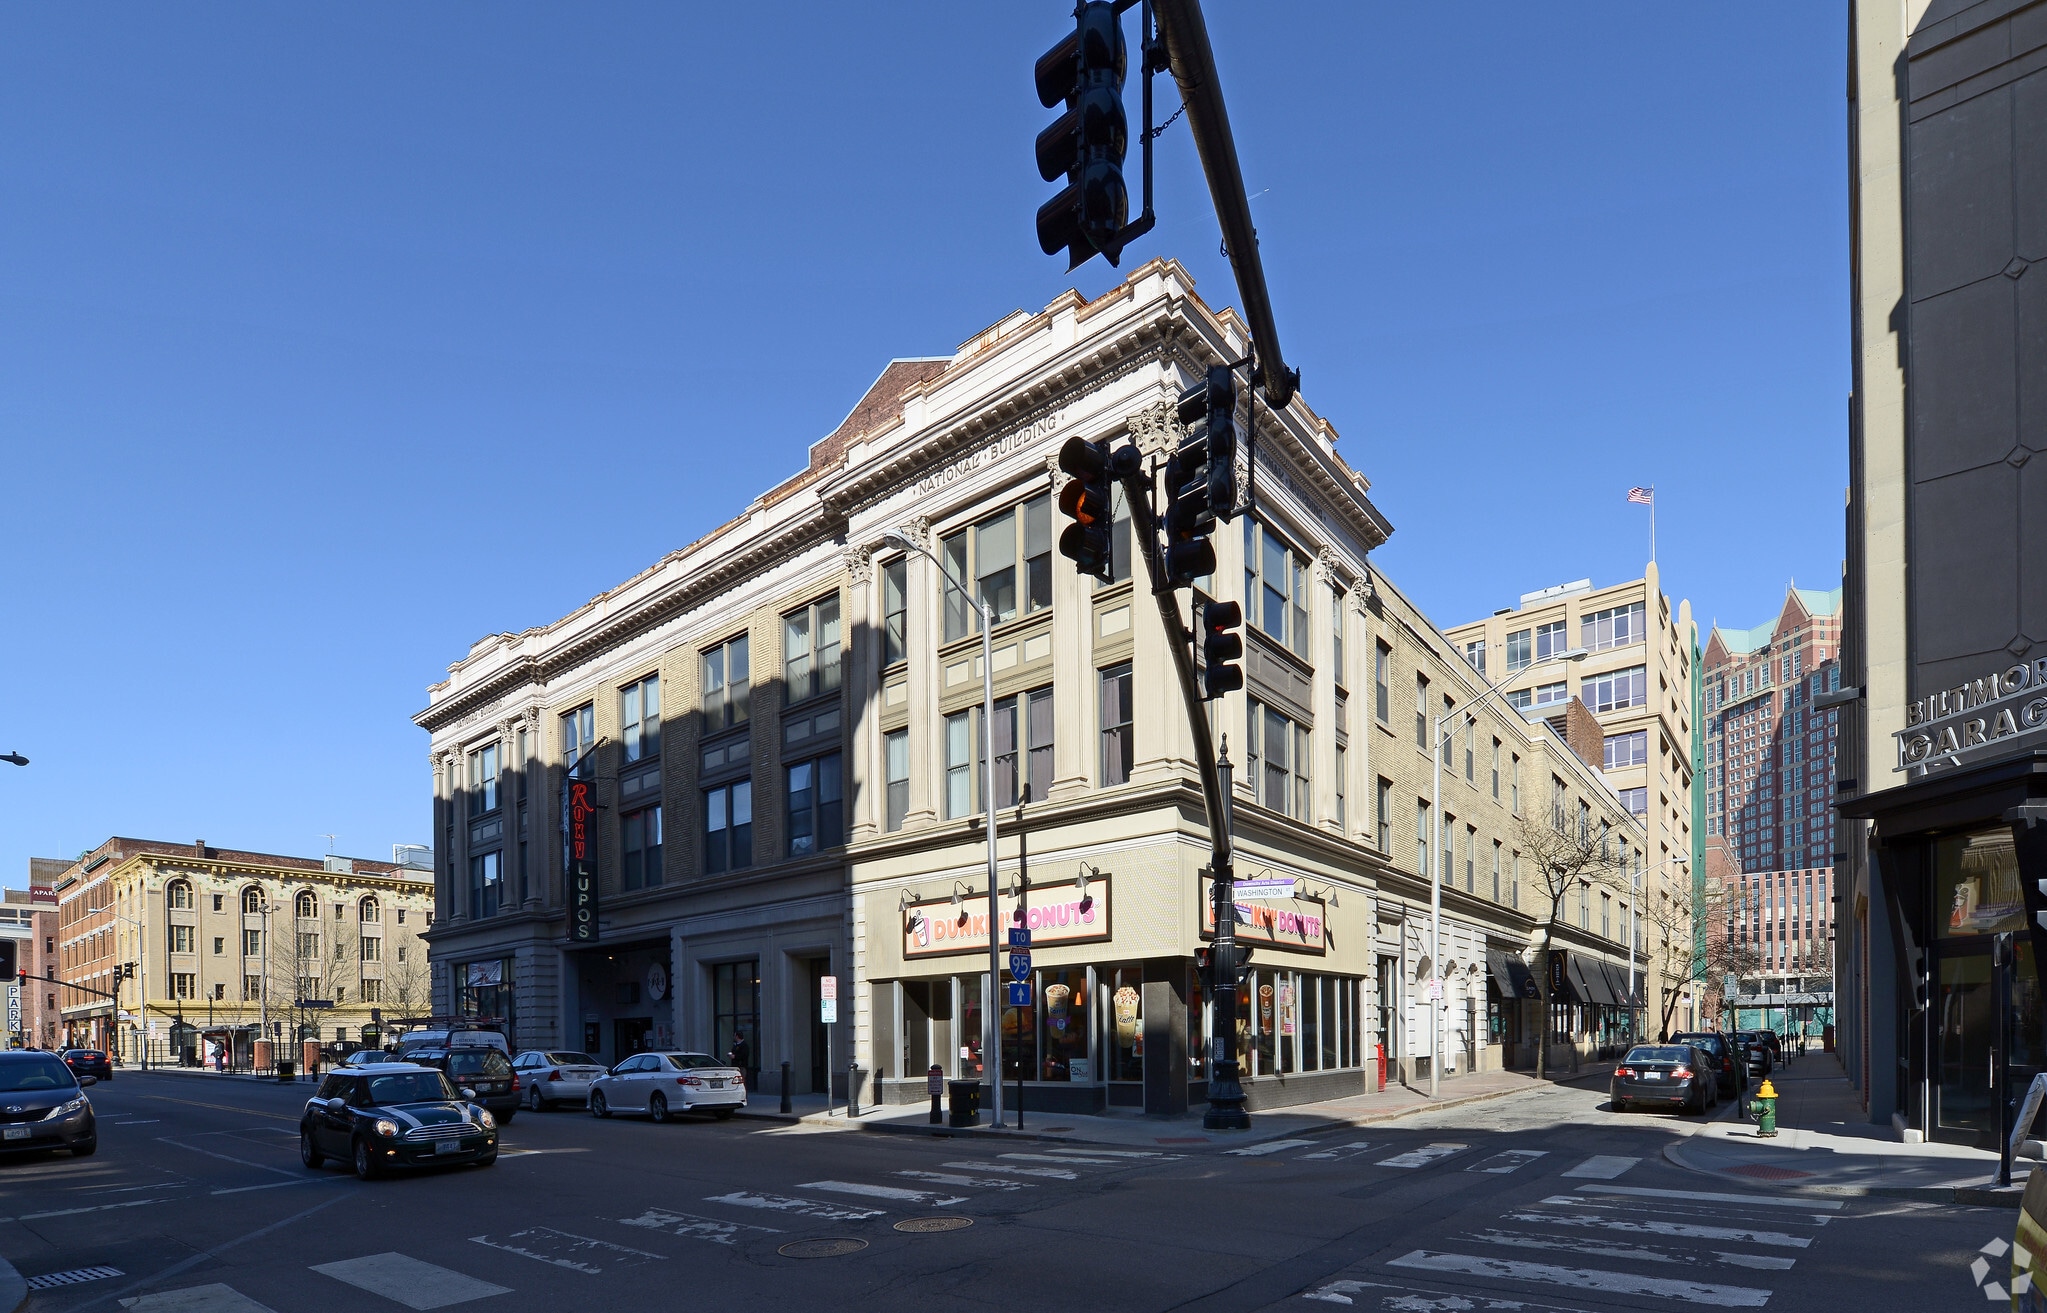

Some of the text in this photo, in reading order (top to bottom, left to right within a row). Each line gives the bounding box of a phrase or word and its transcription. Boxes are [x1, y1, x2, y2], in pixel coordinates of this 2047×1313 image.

[919, 414, 1057, 496] NATIONAL BUILDING
[578, 862, 591, 939] LUPOS
[1237, 888, 1283, 897] WASHINGTON
[1014, 931, 1026, 942] TO
[1279, 910, 1320, 938] DONUTS
[1012, 955, 1029, 974] 95
[10, 987, 19, 1031] PARK
